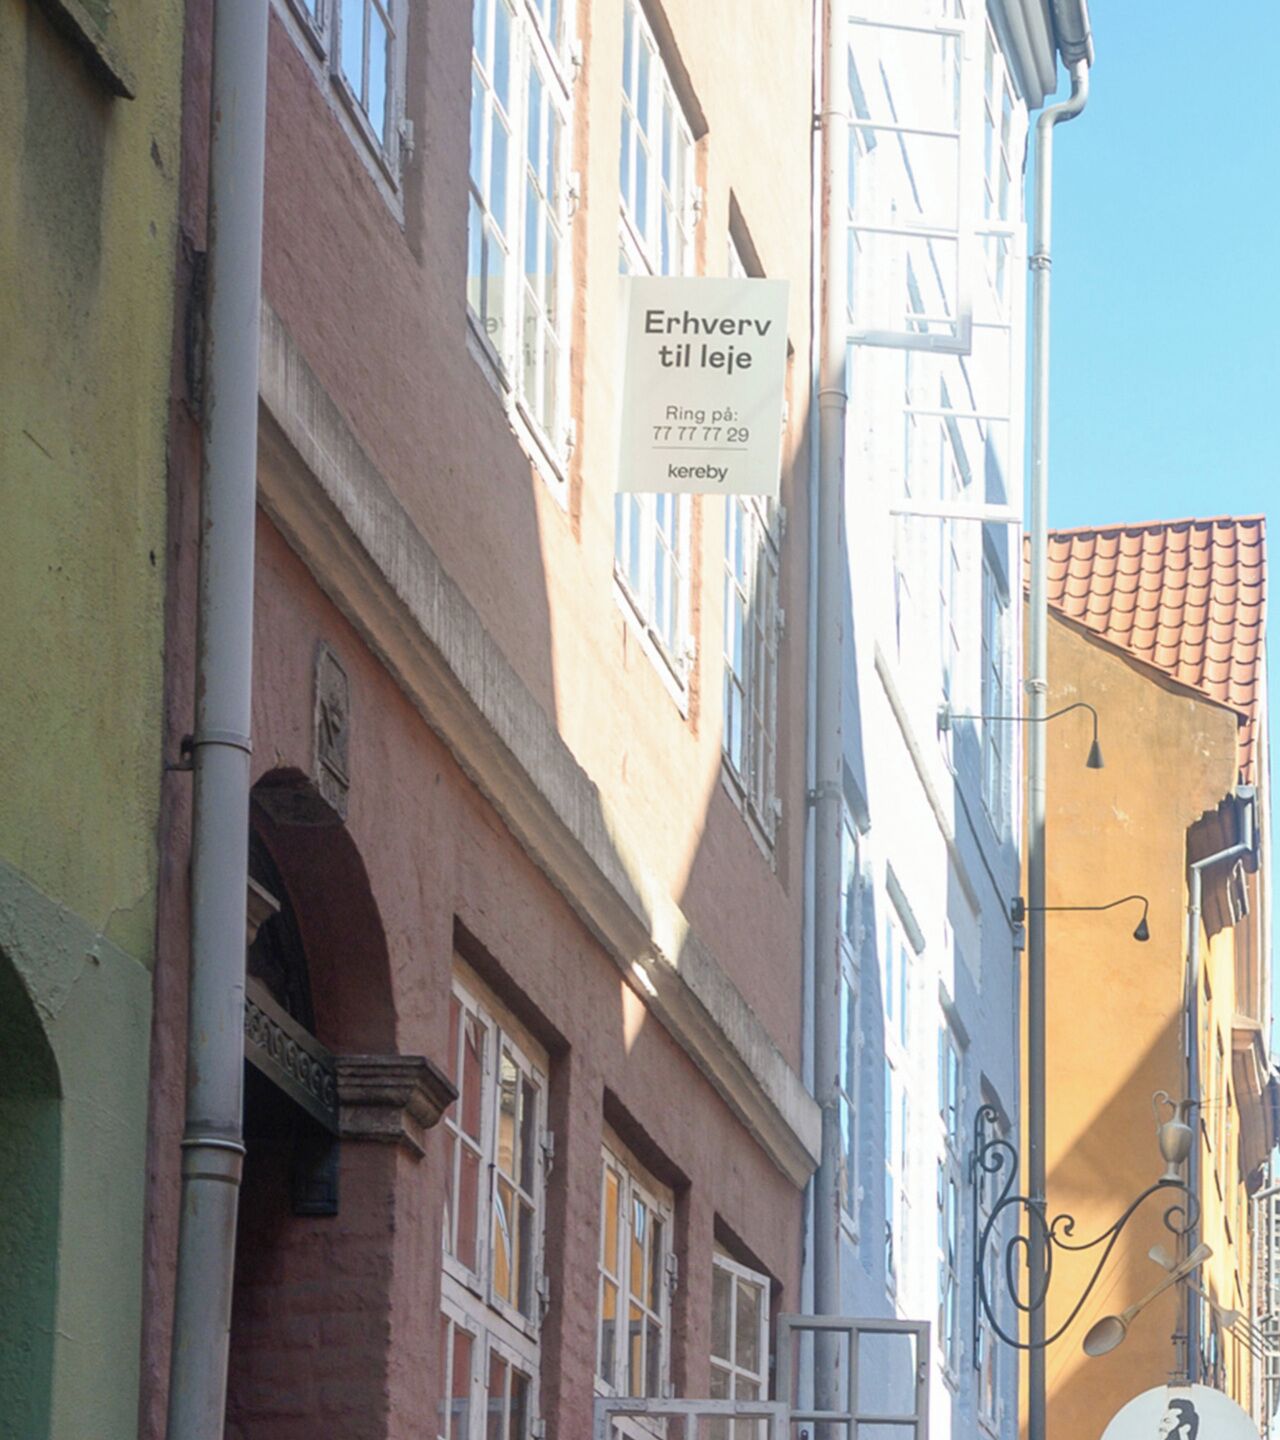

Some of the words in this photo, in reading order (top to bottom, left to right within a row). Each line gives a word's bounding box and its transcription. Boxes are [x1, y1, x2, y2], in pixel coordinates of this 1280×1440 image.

[645, 310, 772, 336] Erhverv
[658, 344, 690, 368] til
[701, 344, 753, 375] leje
[666, 405, 705, 424] Ring
[711, 407, 738, 424] på:
[653, 426, 672, 441] 77
[677, 426, 697, 441] 77
[702, 427, 722, 441] 77
[726, 427, 750, 442] 29
[667, 464, 729, 482] kereby
